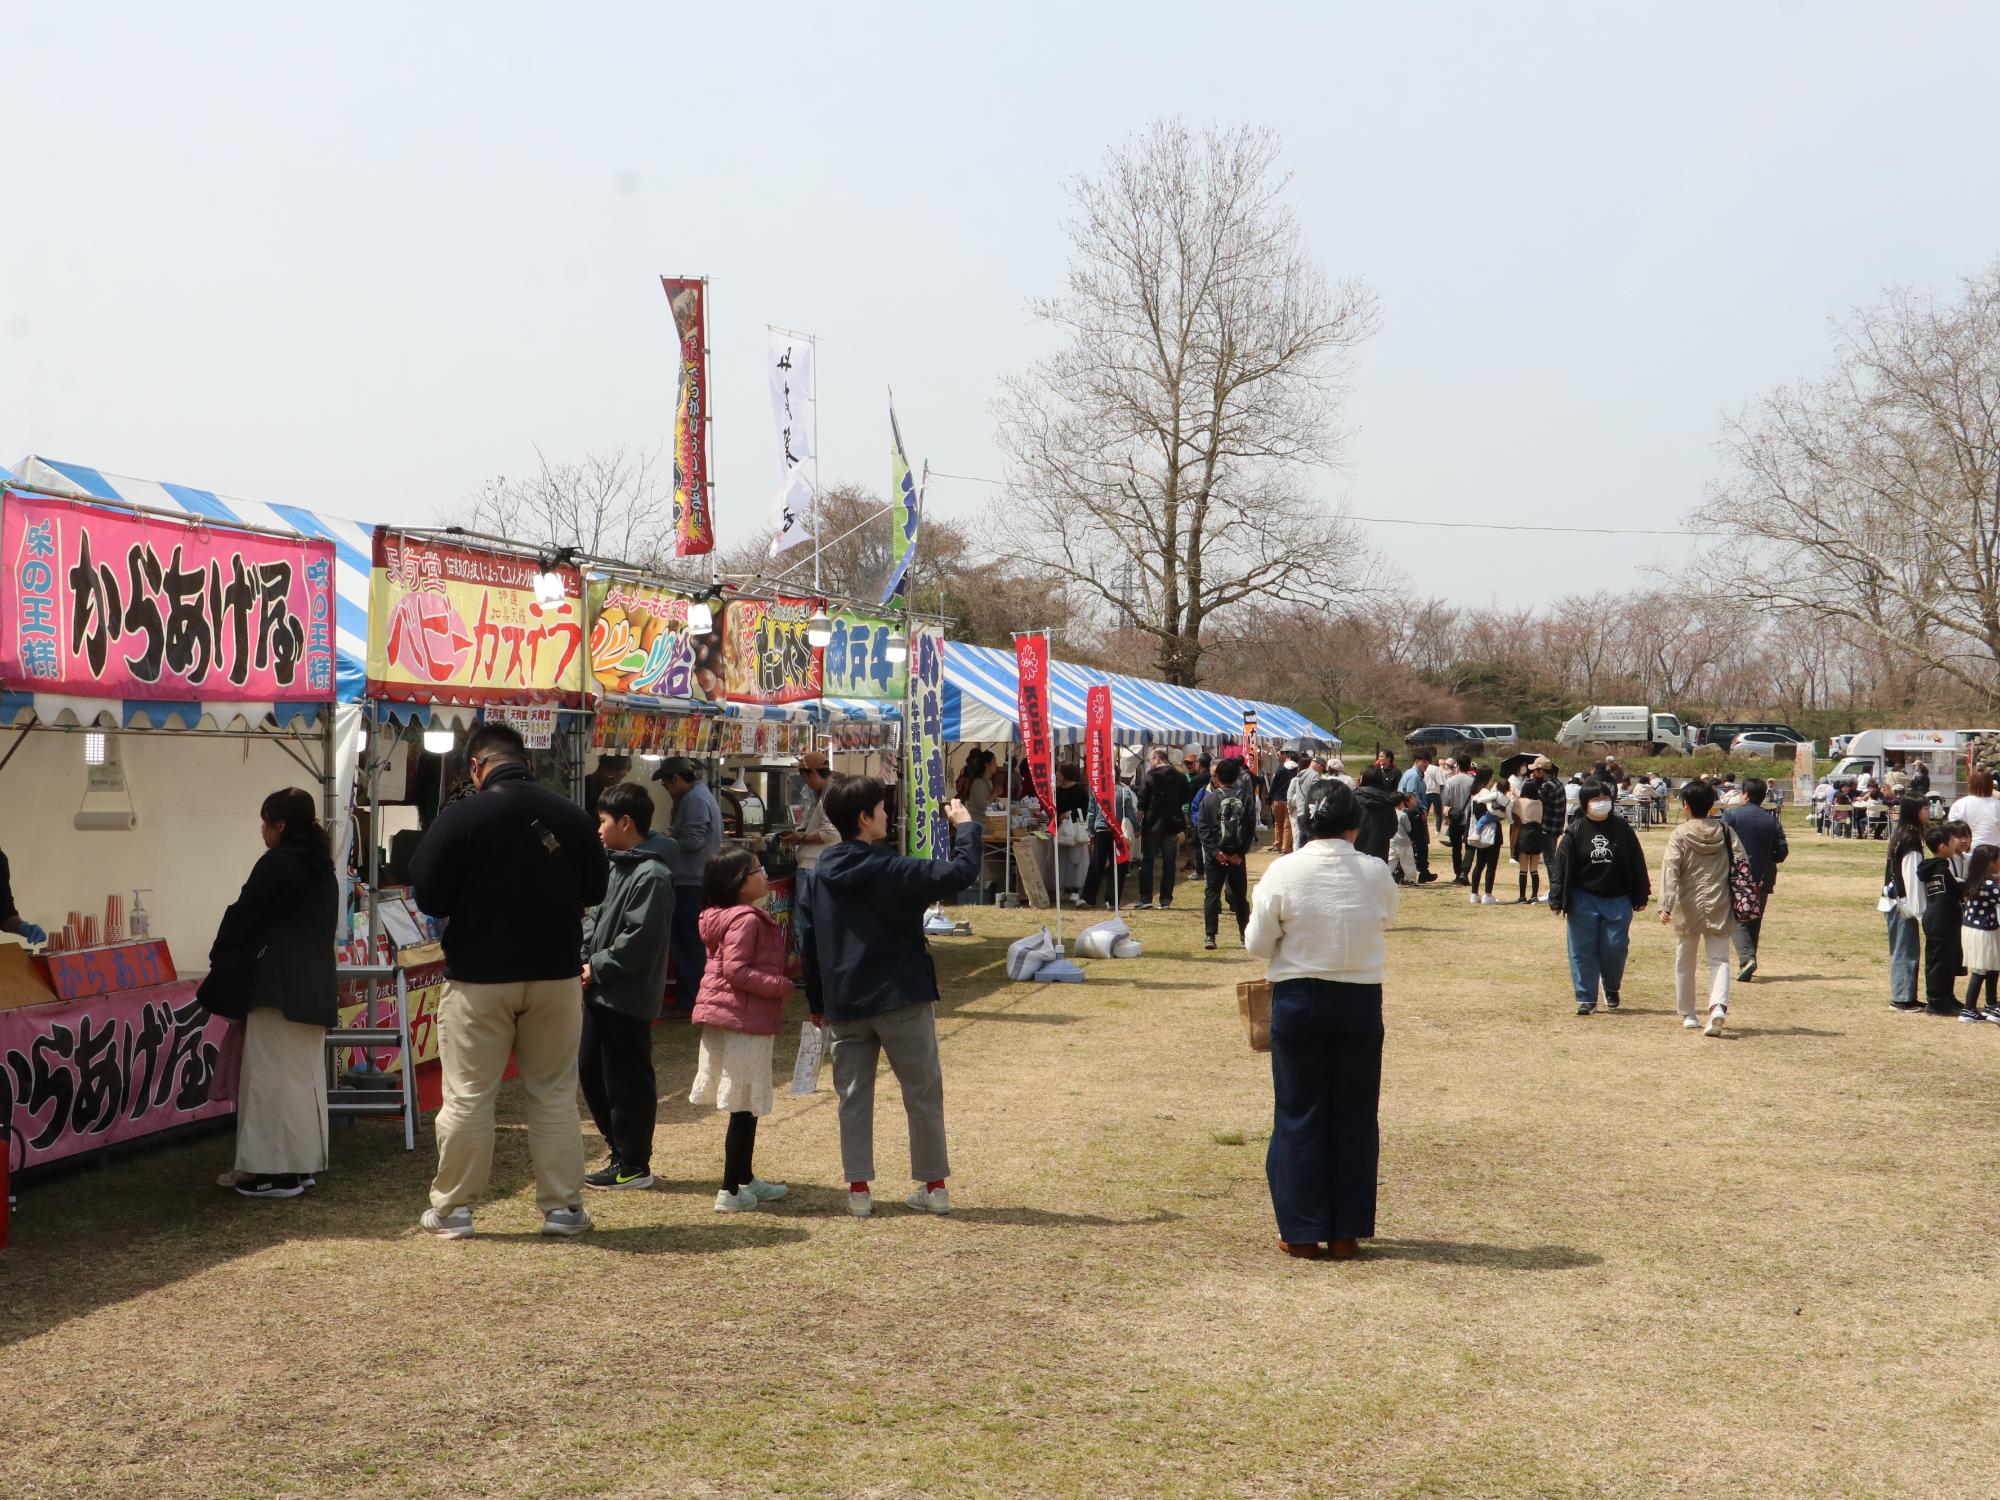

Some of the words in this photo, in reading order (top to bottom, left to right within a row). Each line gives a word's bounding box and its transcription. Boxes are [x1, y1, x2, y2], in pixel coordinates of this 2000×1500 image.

[22, 519, 59, 681] 味の王様
[306, 557, 331, 690] 味の王様
[386, 547, 446, 594] 天狗堂
